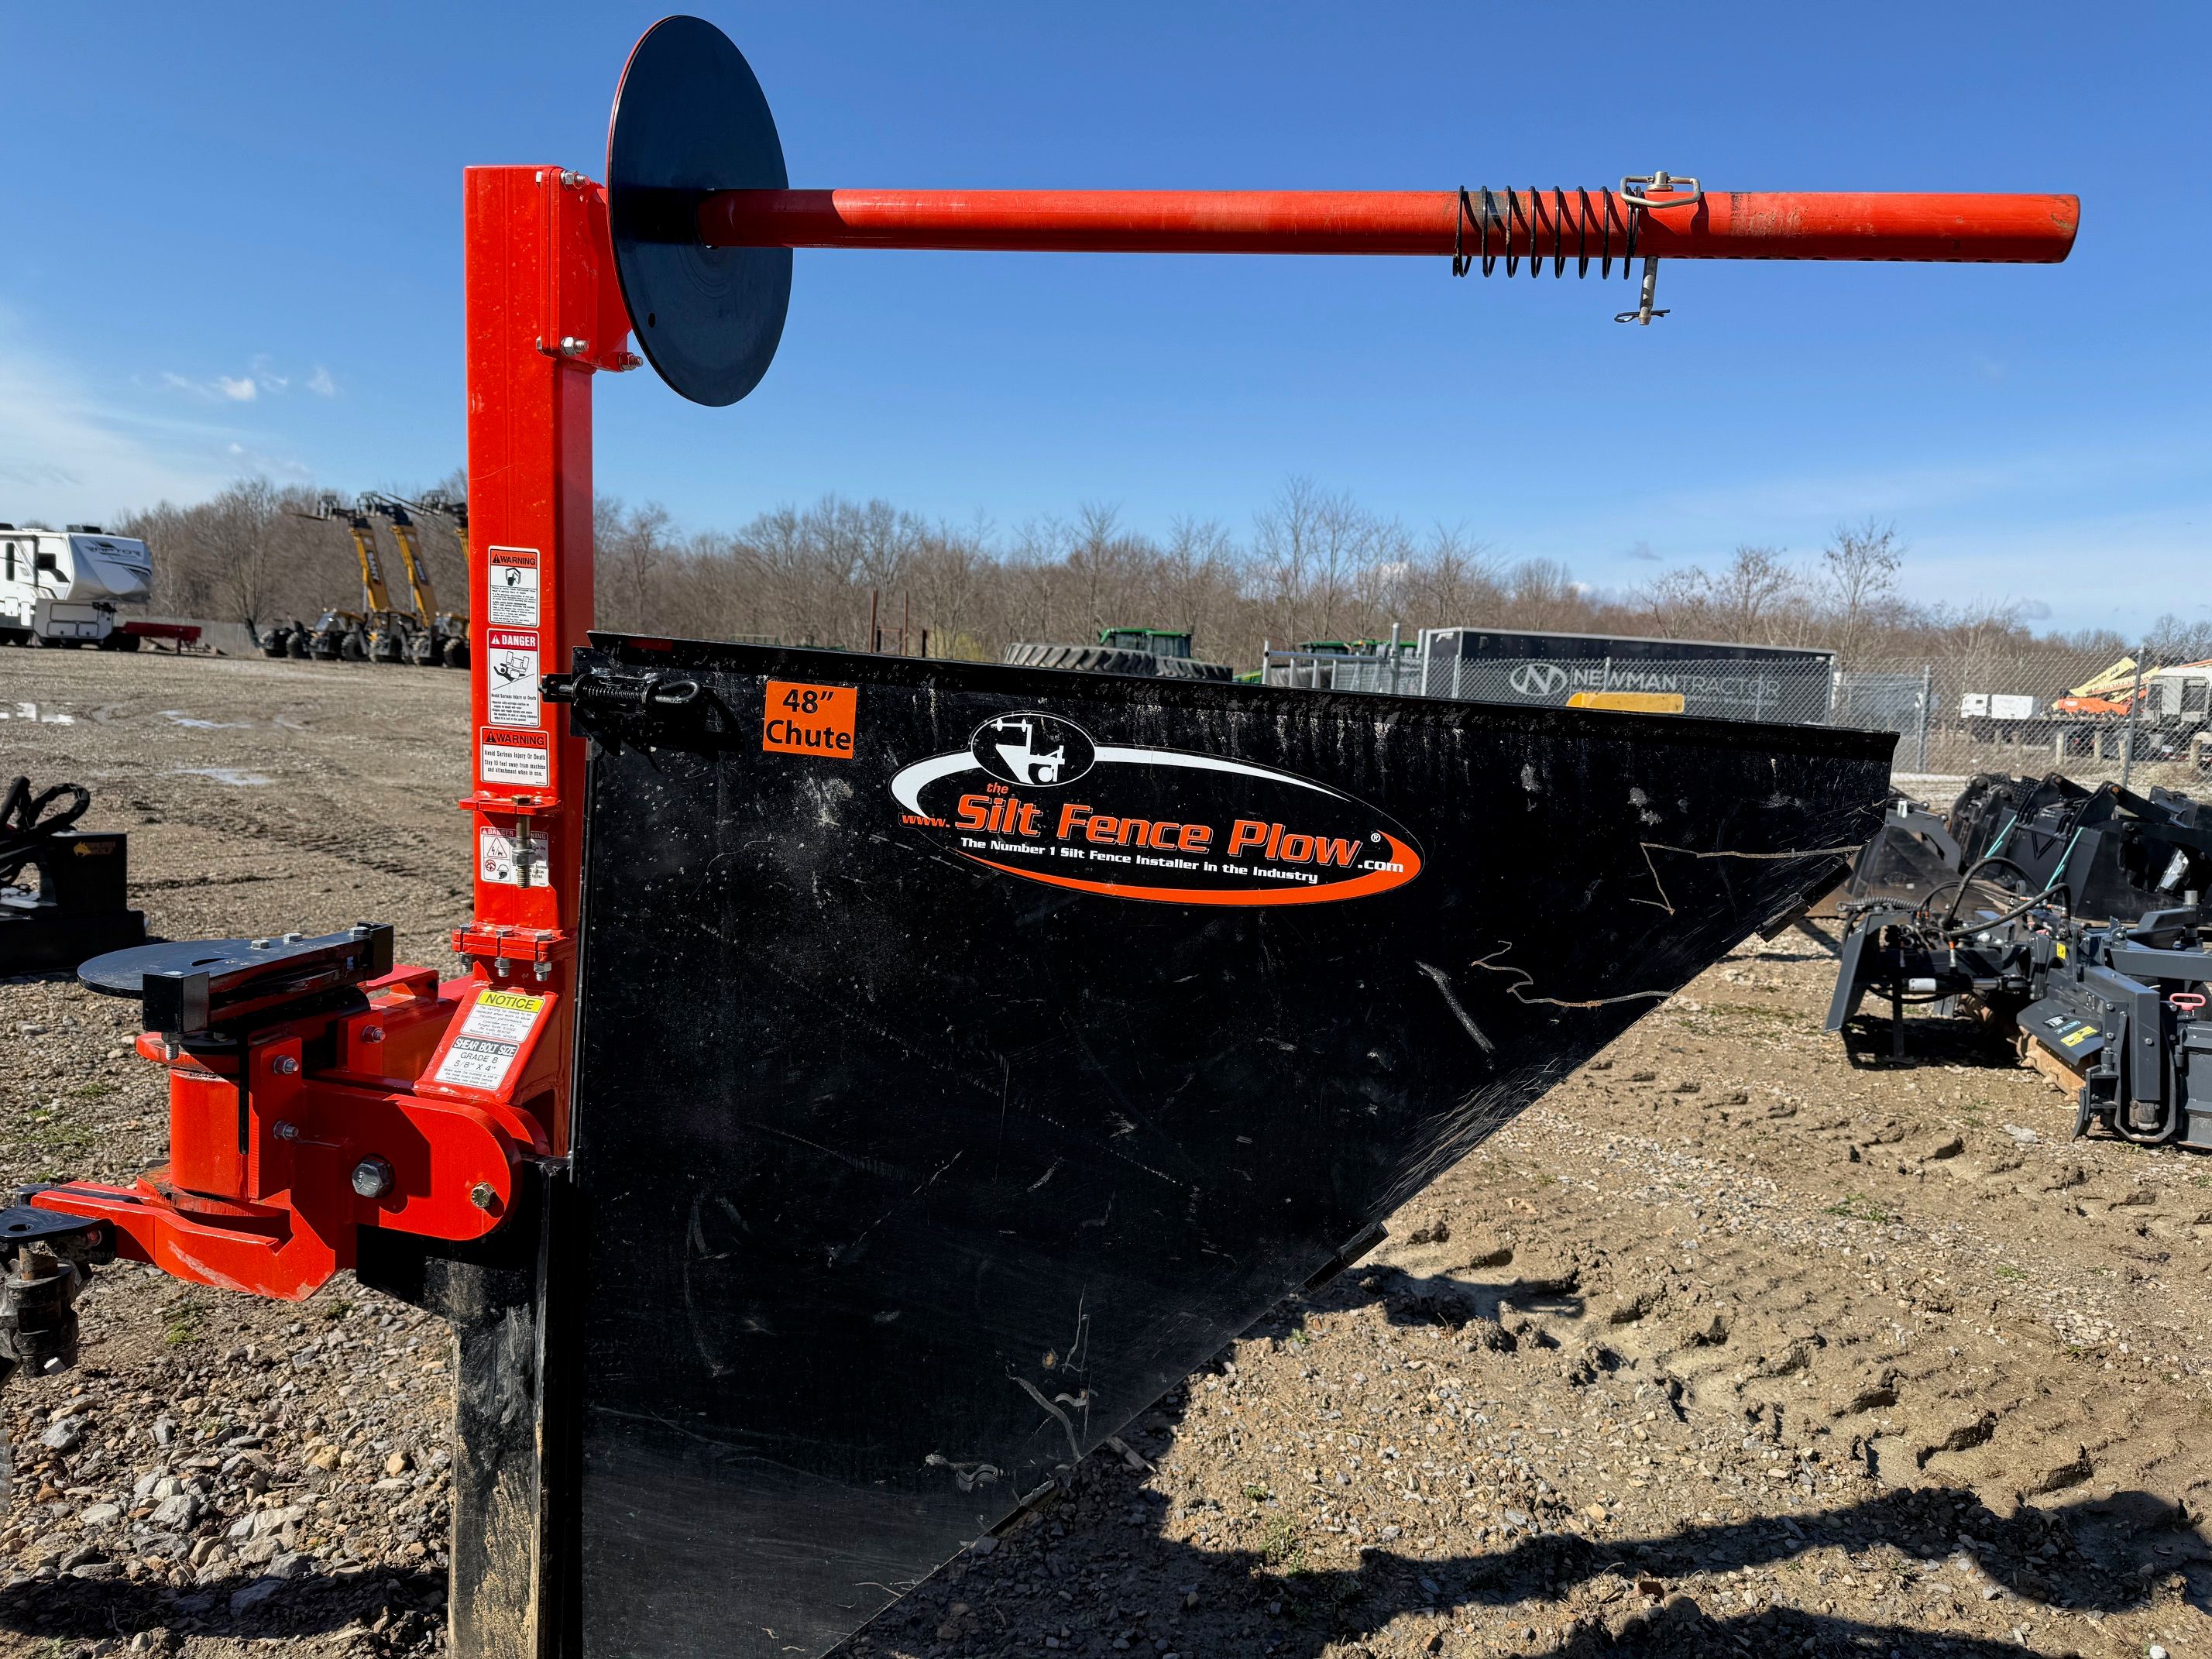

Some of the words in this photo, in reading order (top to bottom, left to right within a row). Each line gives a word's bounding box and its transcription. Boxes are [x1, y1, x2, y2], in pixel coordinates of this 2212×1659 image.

[500, 555, 536, 565] WARNING
[501, 634, 536, 647] DANGER
[782, 689, 834, 714] 48"
[496, 733, 544, 745] WARNING
[766, 720, 851, 750] Chute
[986, 782, 1009, 795] the
[902, 815, 950, 828] www.
[955, 794, 1042, 837] Silt
[1056, 803, 1213, 854] Fence
[1228, 819, 1363, 868] Plow
[960, 837, 987, 850] The
[991, 840, 1046, 855] Number
[1049, 846, 1056, 856] 1
[1060, 847, 1085, 859] Silt
[1089, 850, 1131, 864] Fence
[1136, 854, 1200, 870] Installer
[1204, 860, 1218, 872] in
[1222, 864, 1248, 875] the
[1253, 866, 1318, 884] Industry
[1358, 859, 1404, 874] .com
[486, 994, 536, 1010] NOTICE
[454, 1038, 479, 1050] SHEAR
[479, 1042, 500, 1053] BOLT
[498, 1045, 517, 1056] SIZE
[460, 1052, 489, 1063] GRADE
